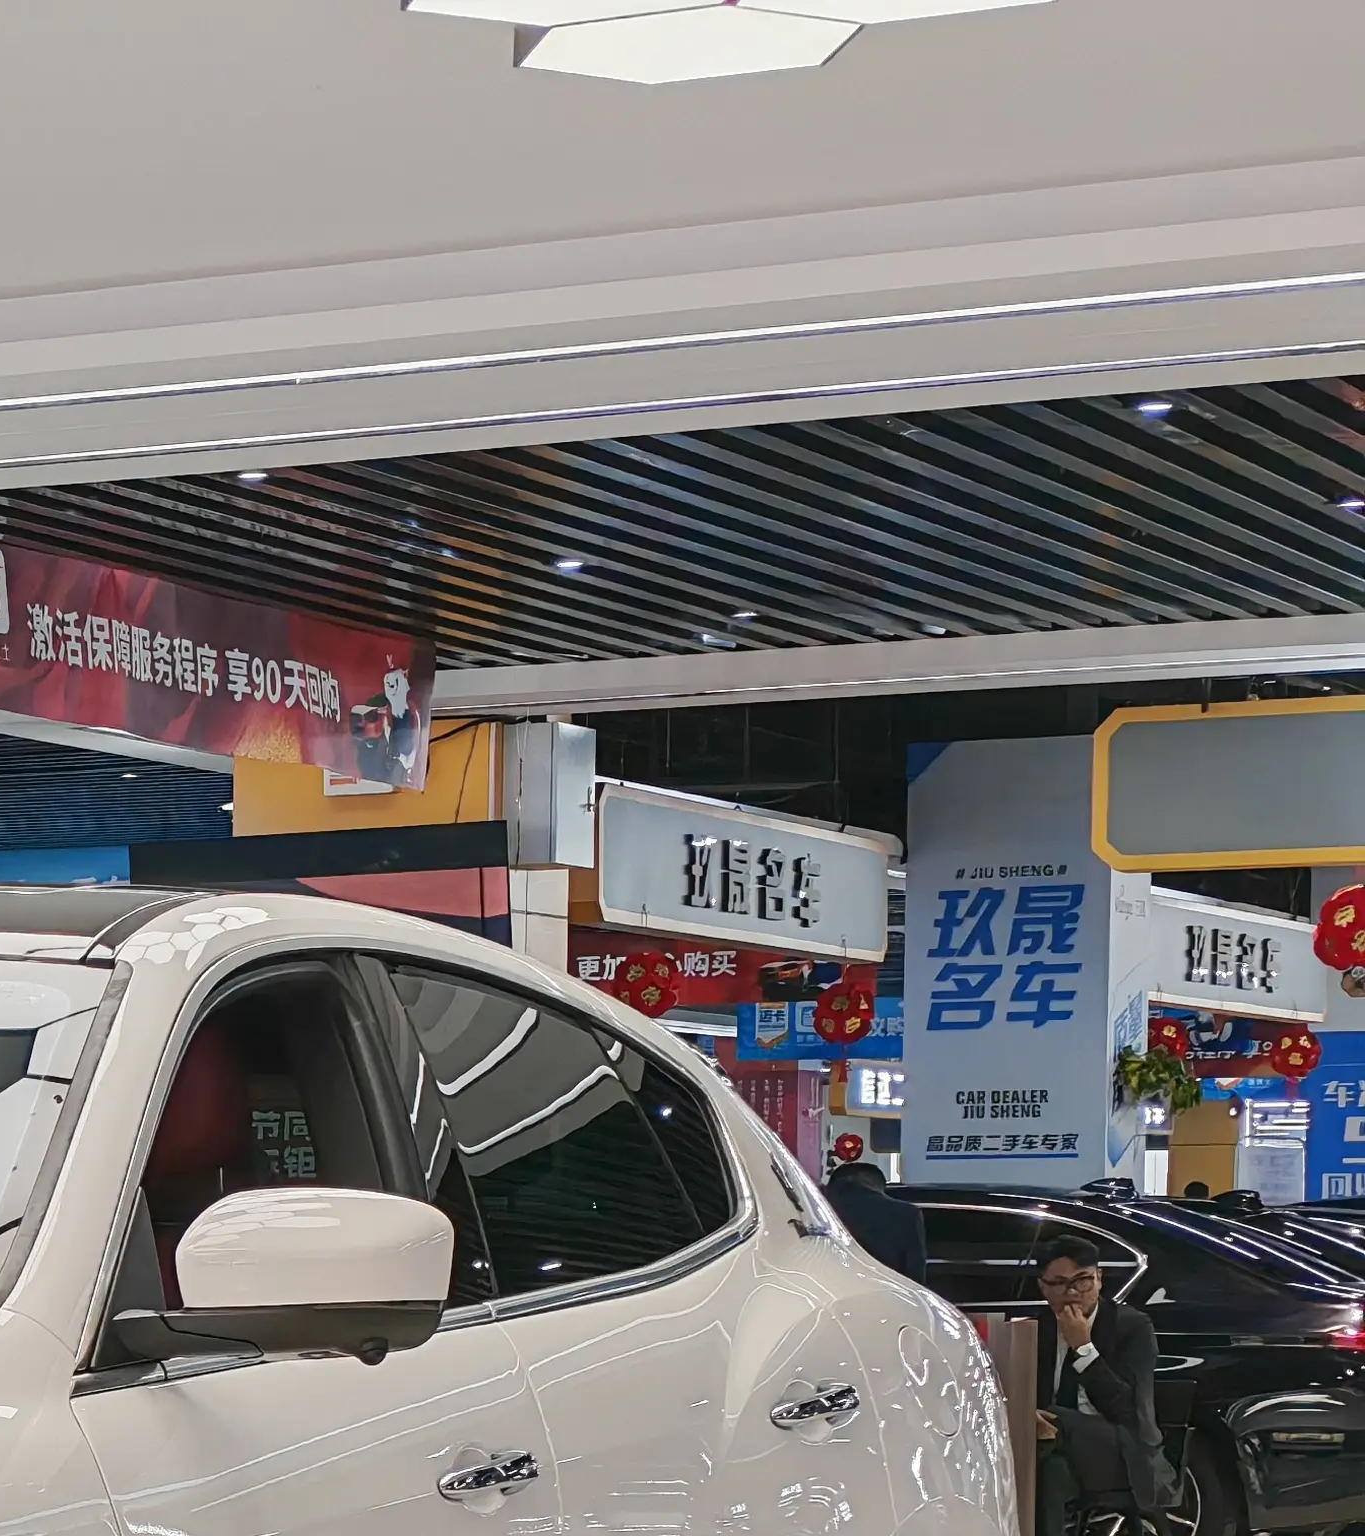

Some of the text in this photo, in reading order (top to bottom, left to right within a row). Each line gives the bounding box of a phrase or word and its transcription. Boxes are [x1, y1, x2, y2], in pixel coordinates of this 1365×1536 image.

[26, 602, 342, 723] 激活保障服务程序 享90天回购
[970, 866, 995, 880] JIU
[998, 864, 1055, 879] SHENG
[926, 884, 1086, 958] 玖晟
[575, 950, 738, 982] 更加购买
[925, 961, 1084, 1031] 名车
[955, 1089, 1049, 1105] CAR DEALER
[961, 1104, 1042, 1120] JIU SHENG
